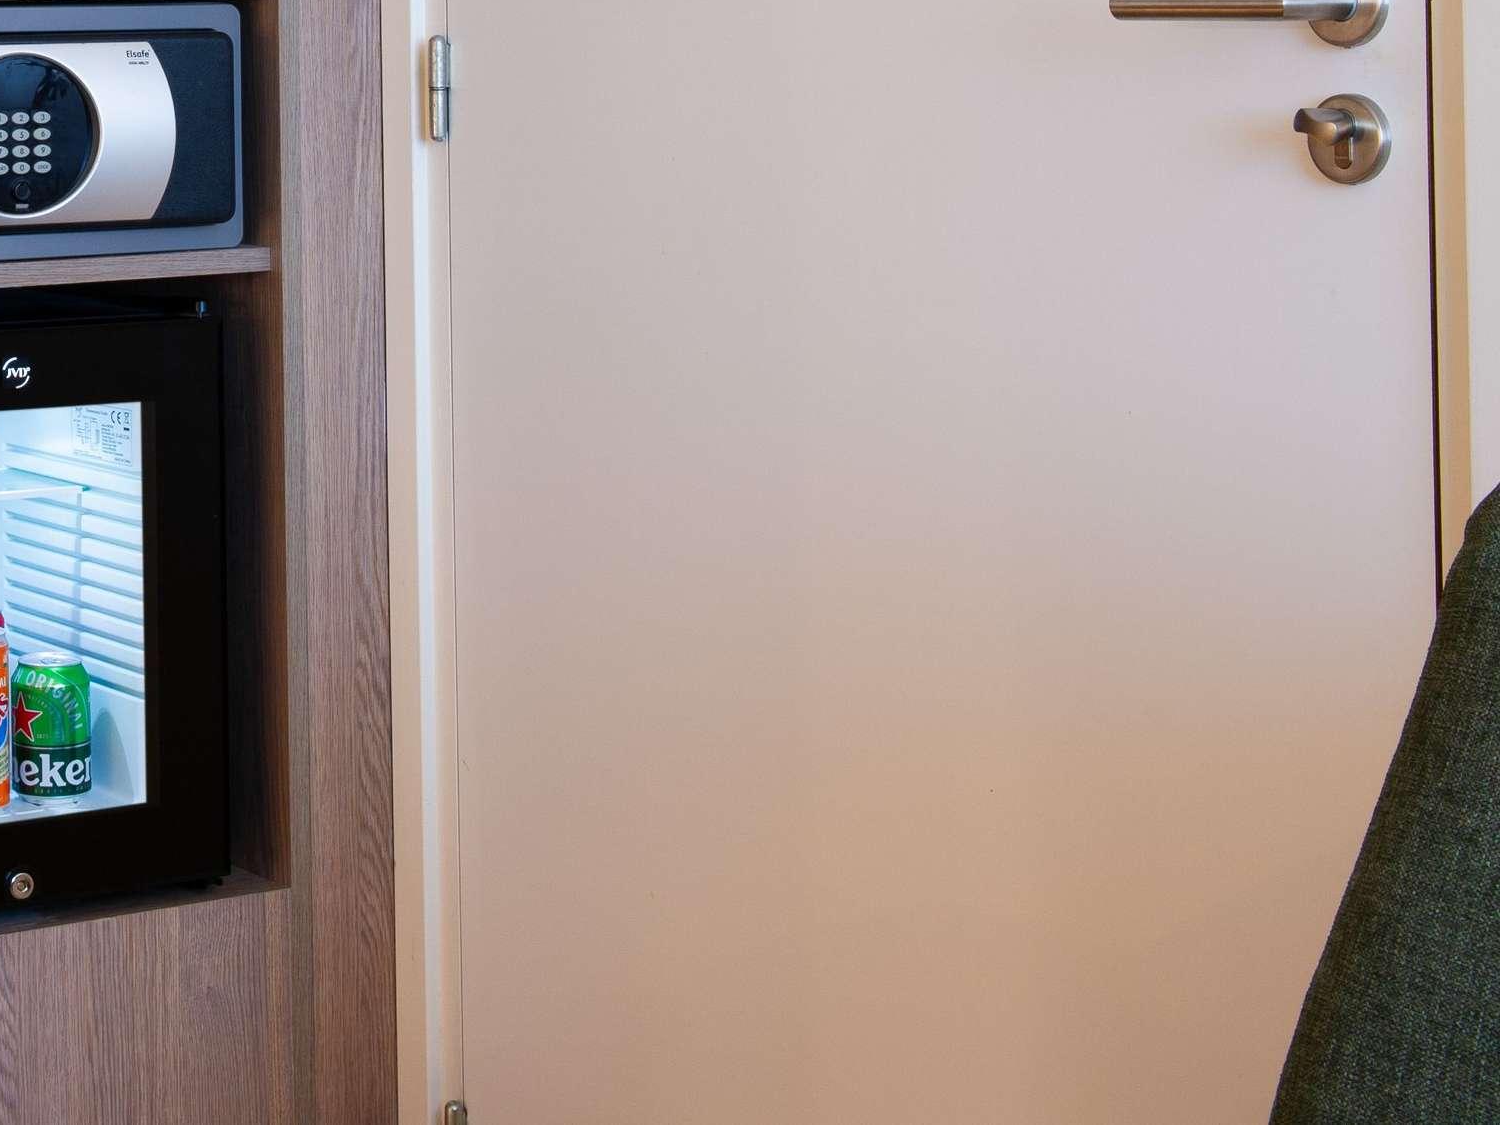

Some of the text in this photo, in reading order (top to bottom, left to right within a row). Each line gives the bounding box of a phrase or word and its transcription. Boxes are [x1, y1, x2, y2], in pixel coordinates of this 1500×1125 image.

[126, 50, 149, 58] Elsafe
[19, 131, 24, 139] 5
[19, 147, 25, 155] 8
[41, 146, 46, 154] 9
